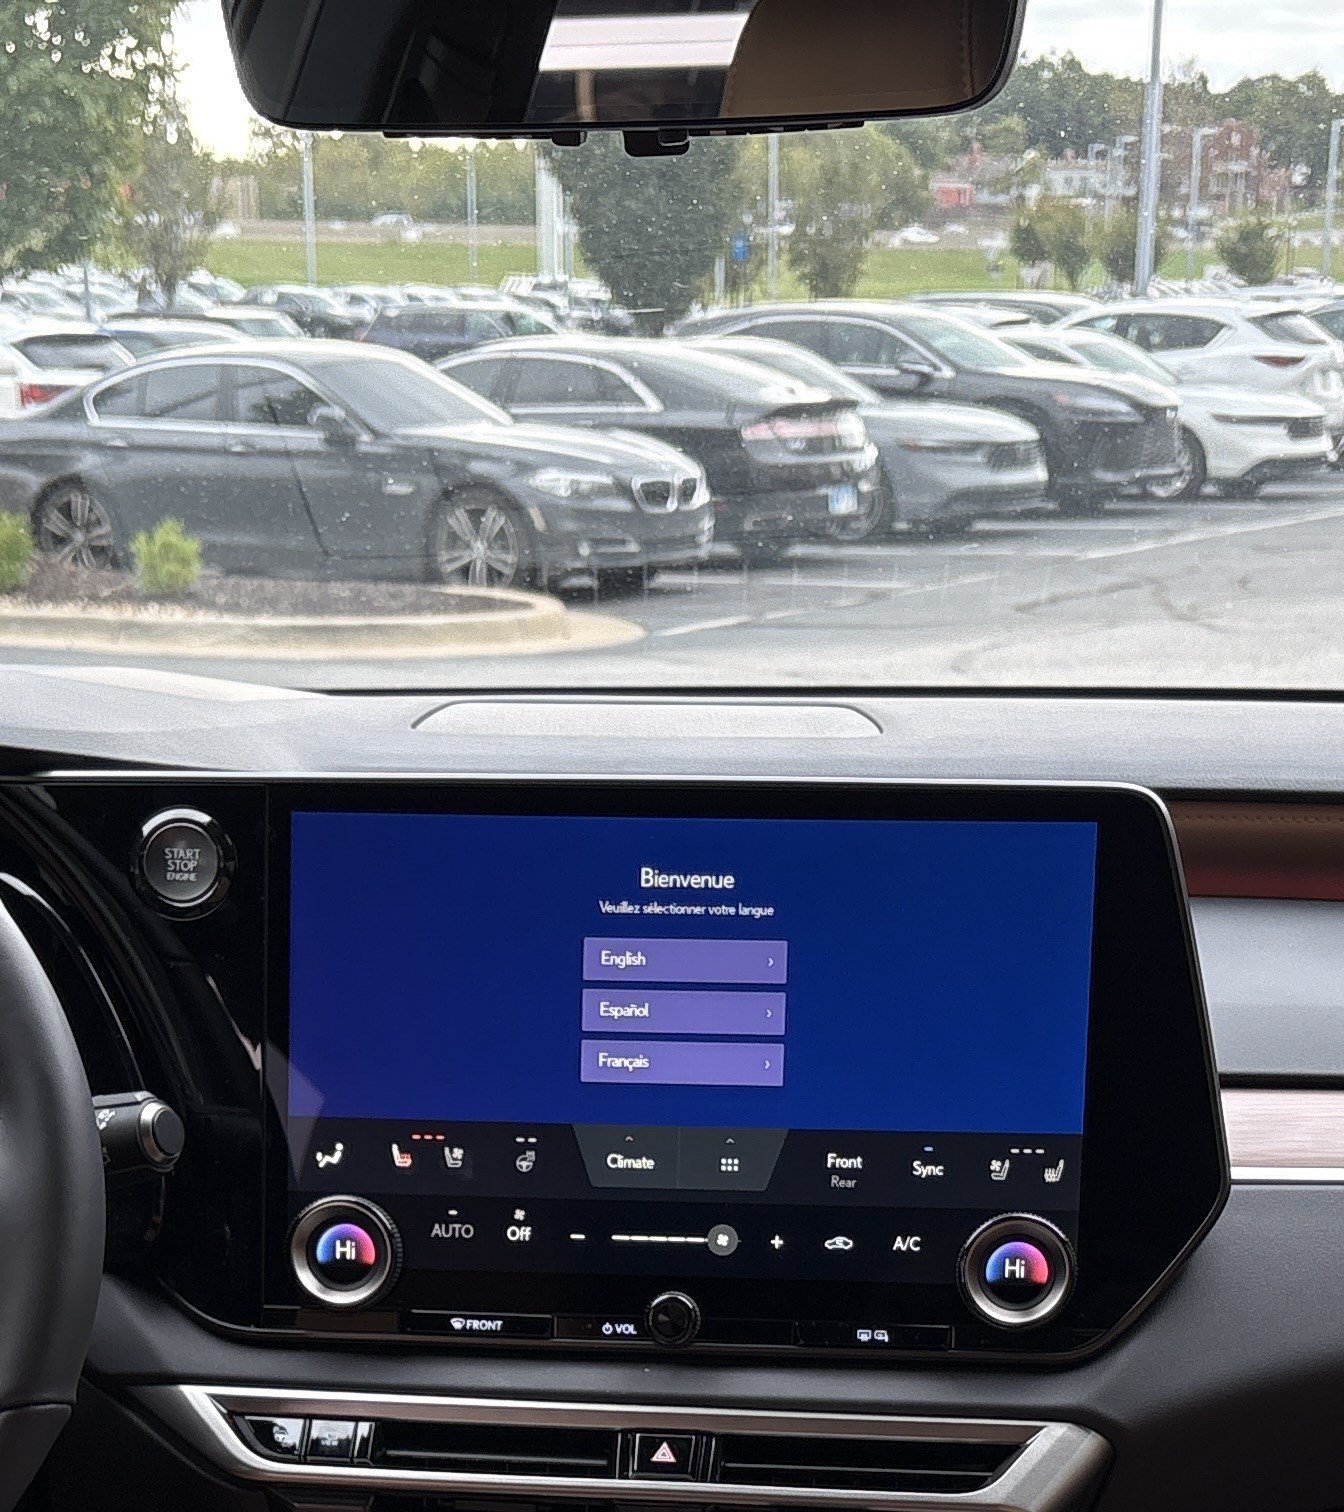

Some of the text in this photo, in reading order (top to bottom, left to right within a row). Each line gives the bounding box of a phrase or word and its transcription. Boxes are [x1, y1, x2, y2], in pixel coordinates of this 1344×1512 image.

[164, 847, 202, 861] START
[167, 860, 198, 872] STOP
[640, 867, 735, 889] Bienvenue
[598, 900, 775, 918] Veuillez sélectionner votre langue
[600, 950, 647, 969] English
[599, 1001, 650, 1020] Español
[598, 1052, 650, 1072] Français
[606, 1153, 655, 1170] Climate
[826, 1152, 863, 1169] Front
[912, 1160, 945, 1178] Sync
[830, 1174, 857, 1188] Rear
[430, 1223, 475, 1239] AUTO
[506, 1225, 532, 1242] Off
[335, 1239, 356, 1260] Hi
[892, 1235, 922, 1252] A/C
[1004, 1257, 1026, 1279] Hi
[465, 1318, 504, 1331] FRONT
[614, 1323, 638, 1335] VOL
